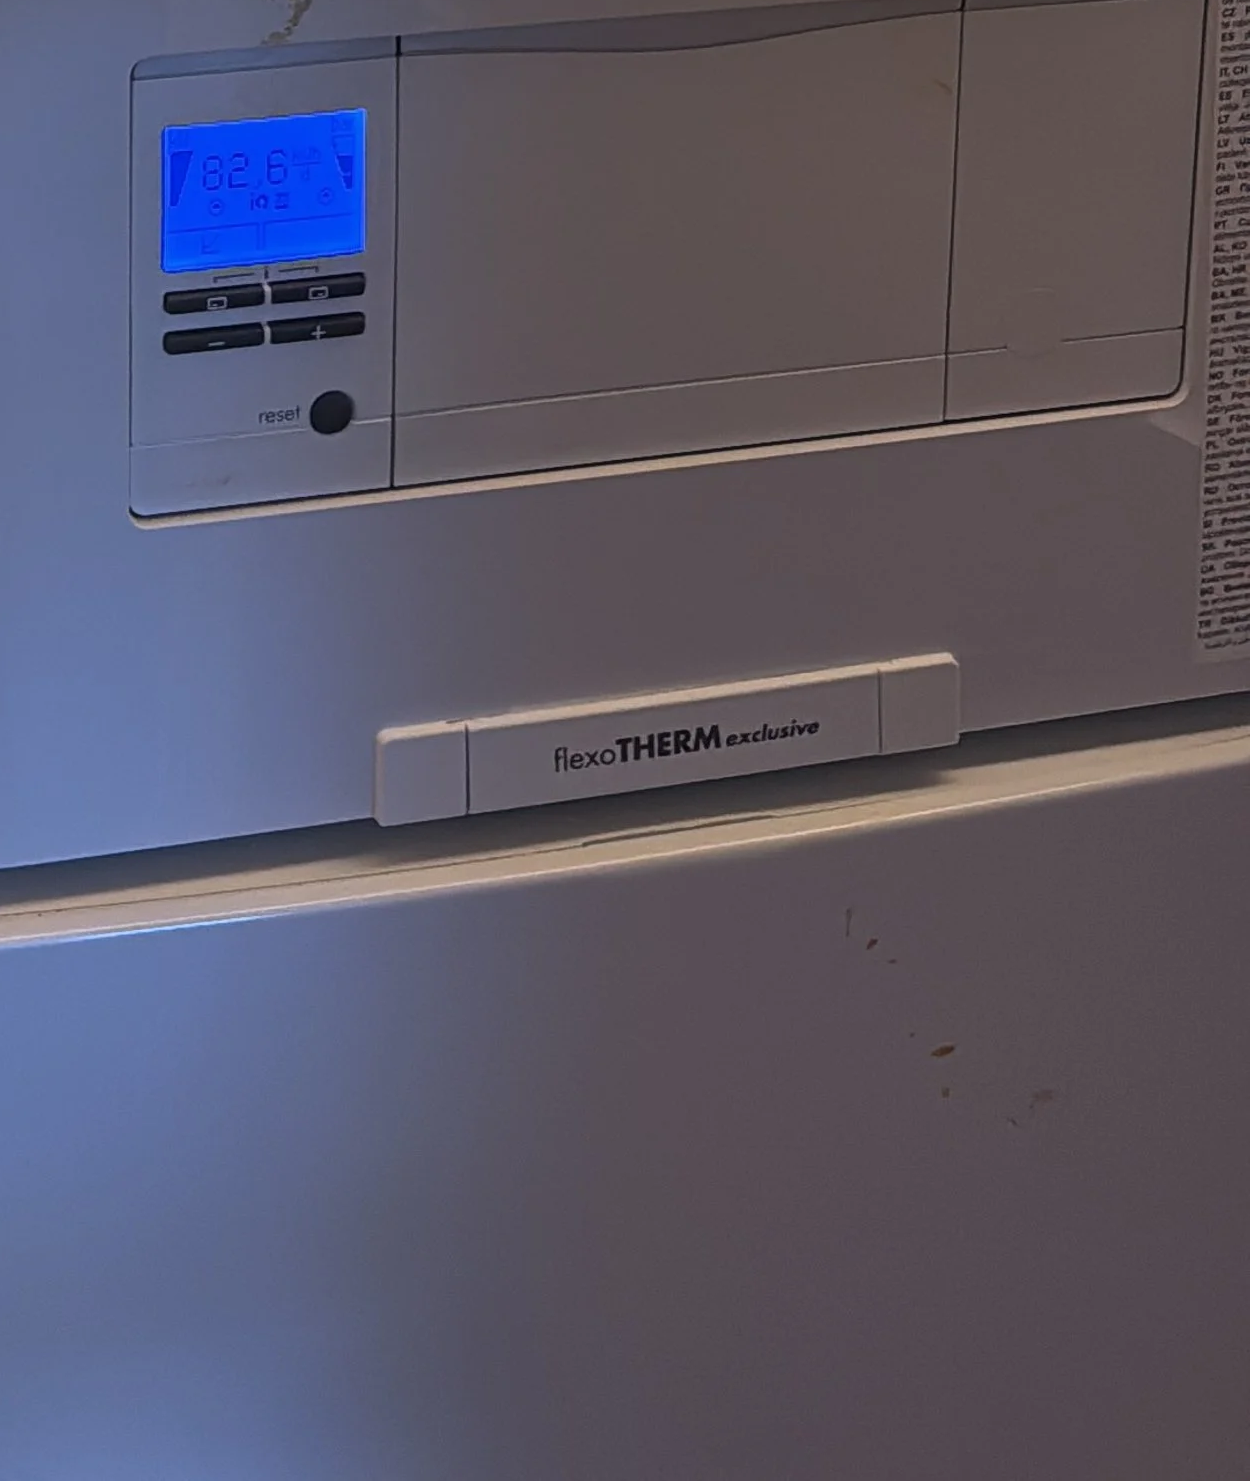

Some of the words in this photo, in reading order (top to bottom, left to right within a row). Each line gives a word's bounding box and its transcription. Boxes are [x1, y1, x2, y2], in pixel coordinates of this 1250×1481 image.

[258, 404, 301, 424] reset
[554, 724, 721, 772] flexoTHERM
[726, 719, 820, 747] exclusive
